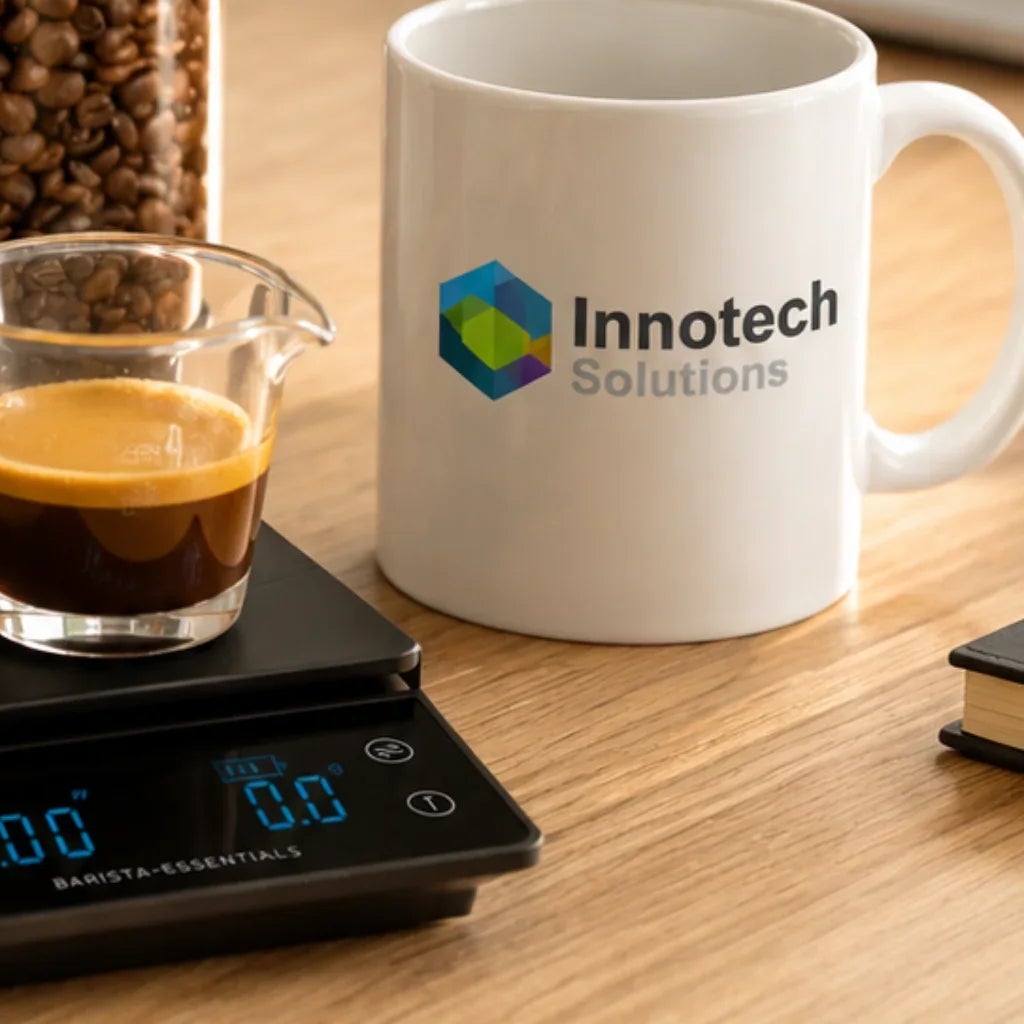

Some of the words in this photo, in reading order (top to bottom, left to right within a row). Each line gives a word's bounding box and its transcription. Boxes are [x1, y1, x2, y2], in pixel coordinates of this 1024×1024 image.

[573, 279, 839, 351] Innotech
[570, 357, 789, 398] Solutions
[52, 844, 303, 891] BARISTA-ESSENTIALS
